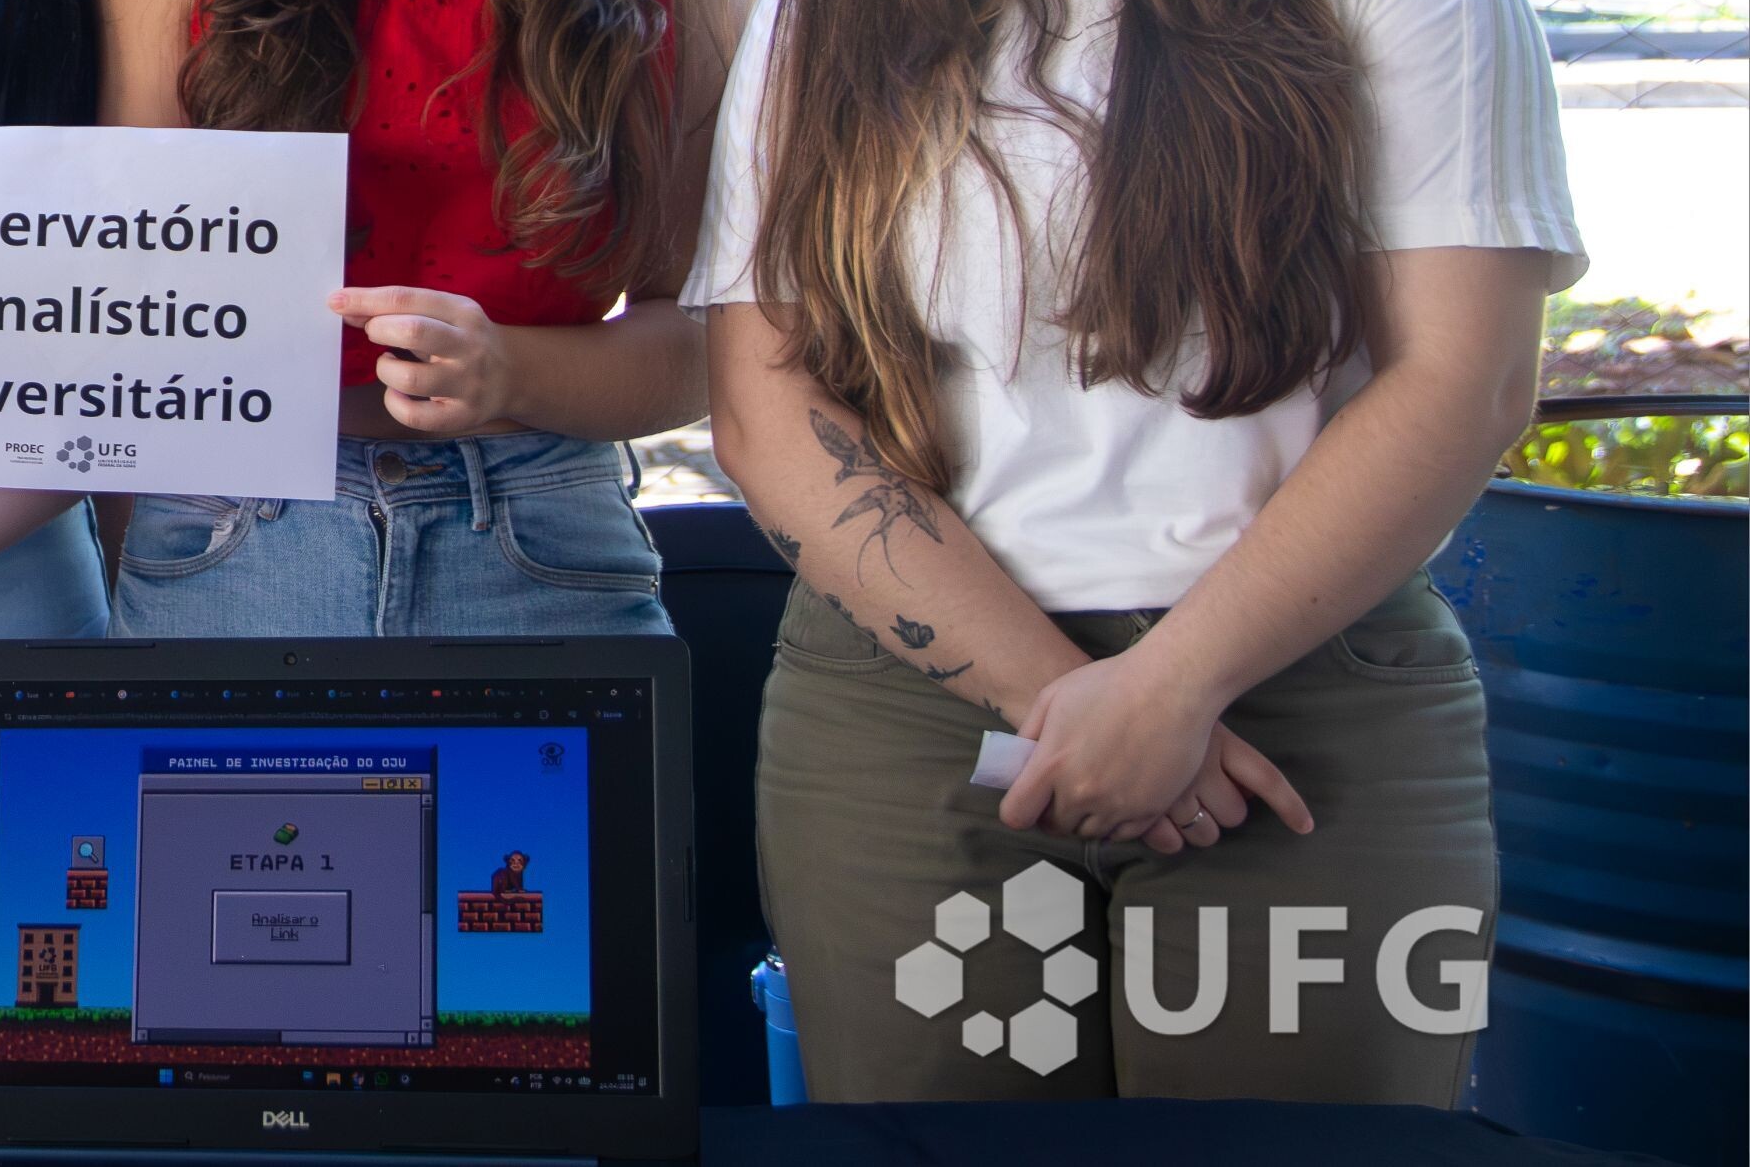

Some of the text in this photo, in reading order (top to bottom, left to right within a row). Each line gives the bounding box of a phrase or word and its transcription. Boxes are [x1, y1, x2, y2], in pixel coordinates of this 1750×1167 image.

[5, 442, 44, 454] PROEC
[98, 443, 137, 457] UFG
[169, 755, 406, 770] PAINEL DE INVESTIGAÇÃO DO OJU
[230, 854, 334, 871] ETAPA 1
[252, 913, 319, 926] Analisar o
[270, 927, 299, 941] Link
[263, 1110, 310, 1127] DELL
